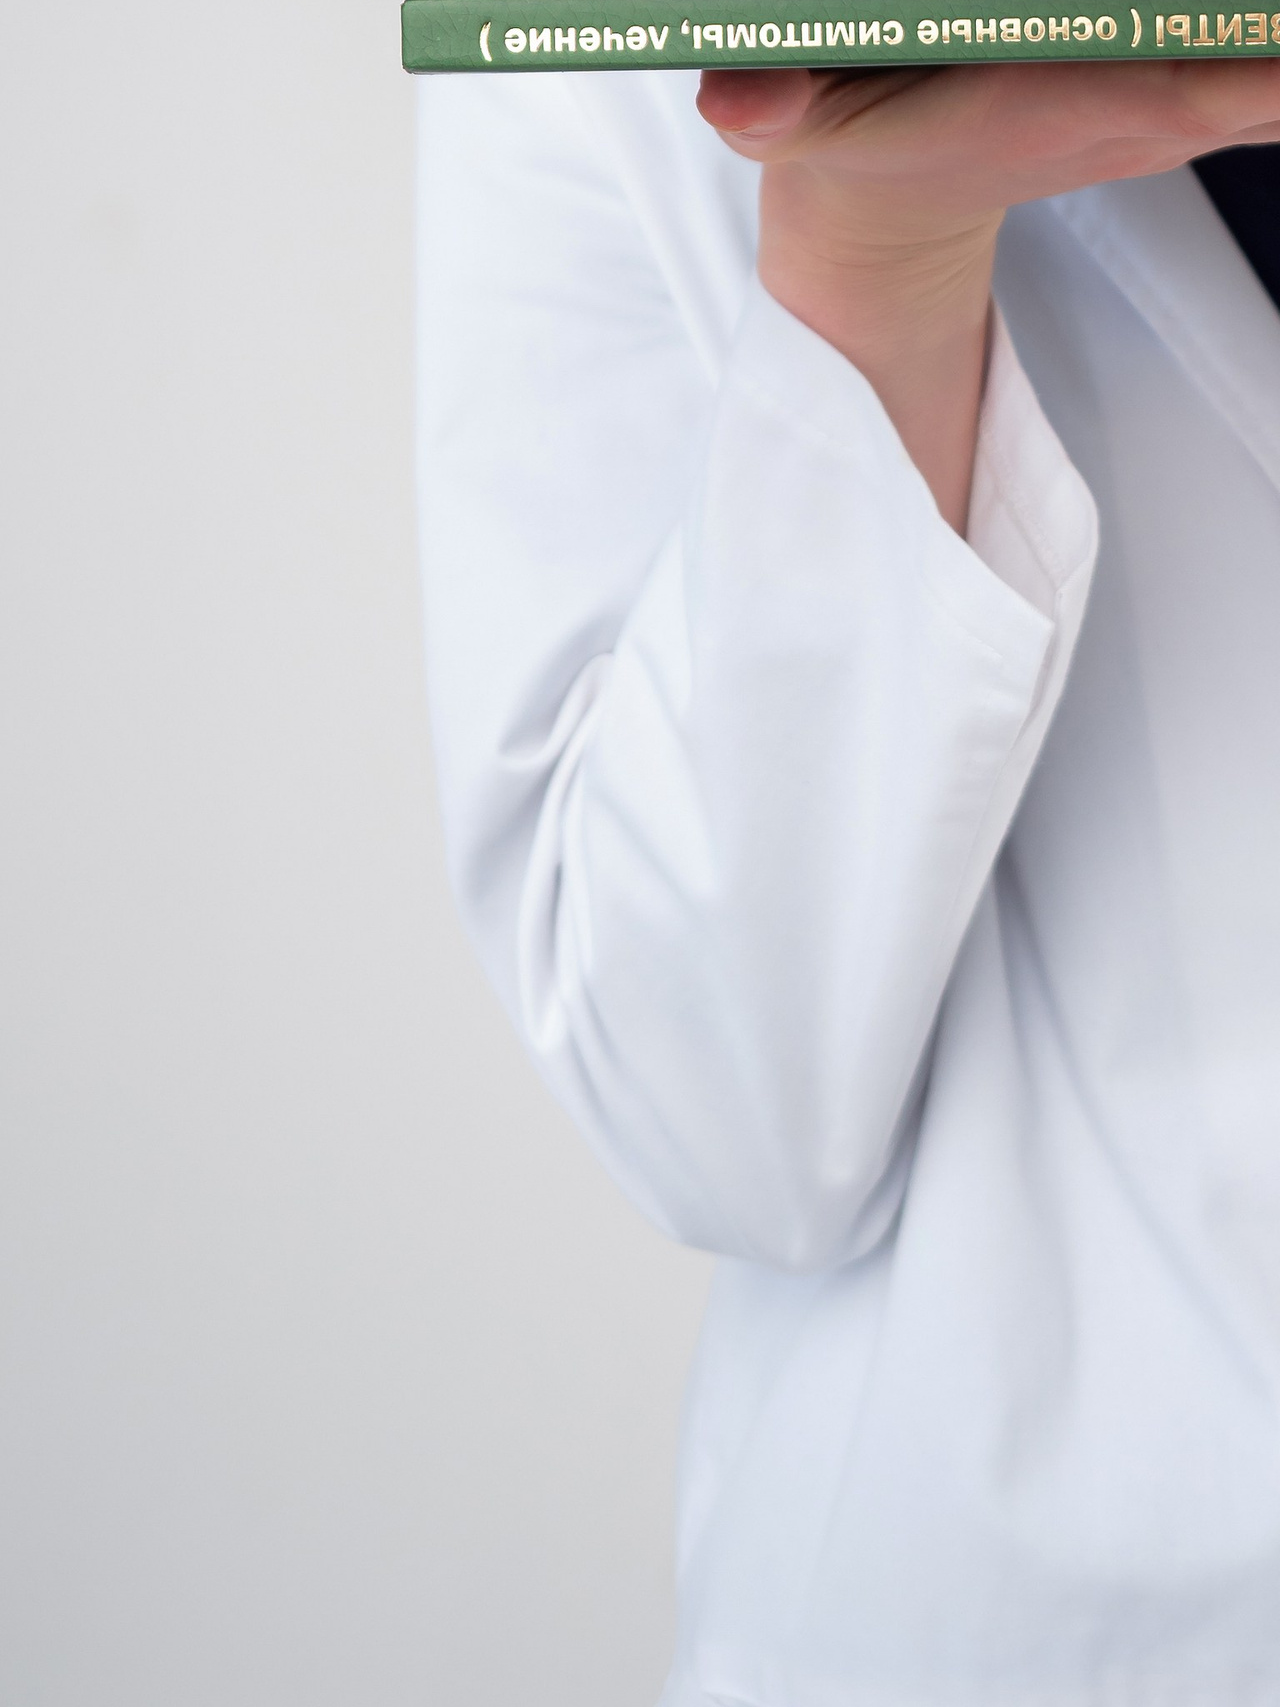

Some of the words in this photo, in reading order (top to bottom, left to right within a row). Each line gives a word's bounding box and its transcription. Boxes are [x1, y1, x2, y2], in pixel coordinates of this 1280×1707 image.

[504, 26, 669, 56] лечение
[681, 19, 905, 50] симптомы,
[917, 15, 1118, 44] основные
